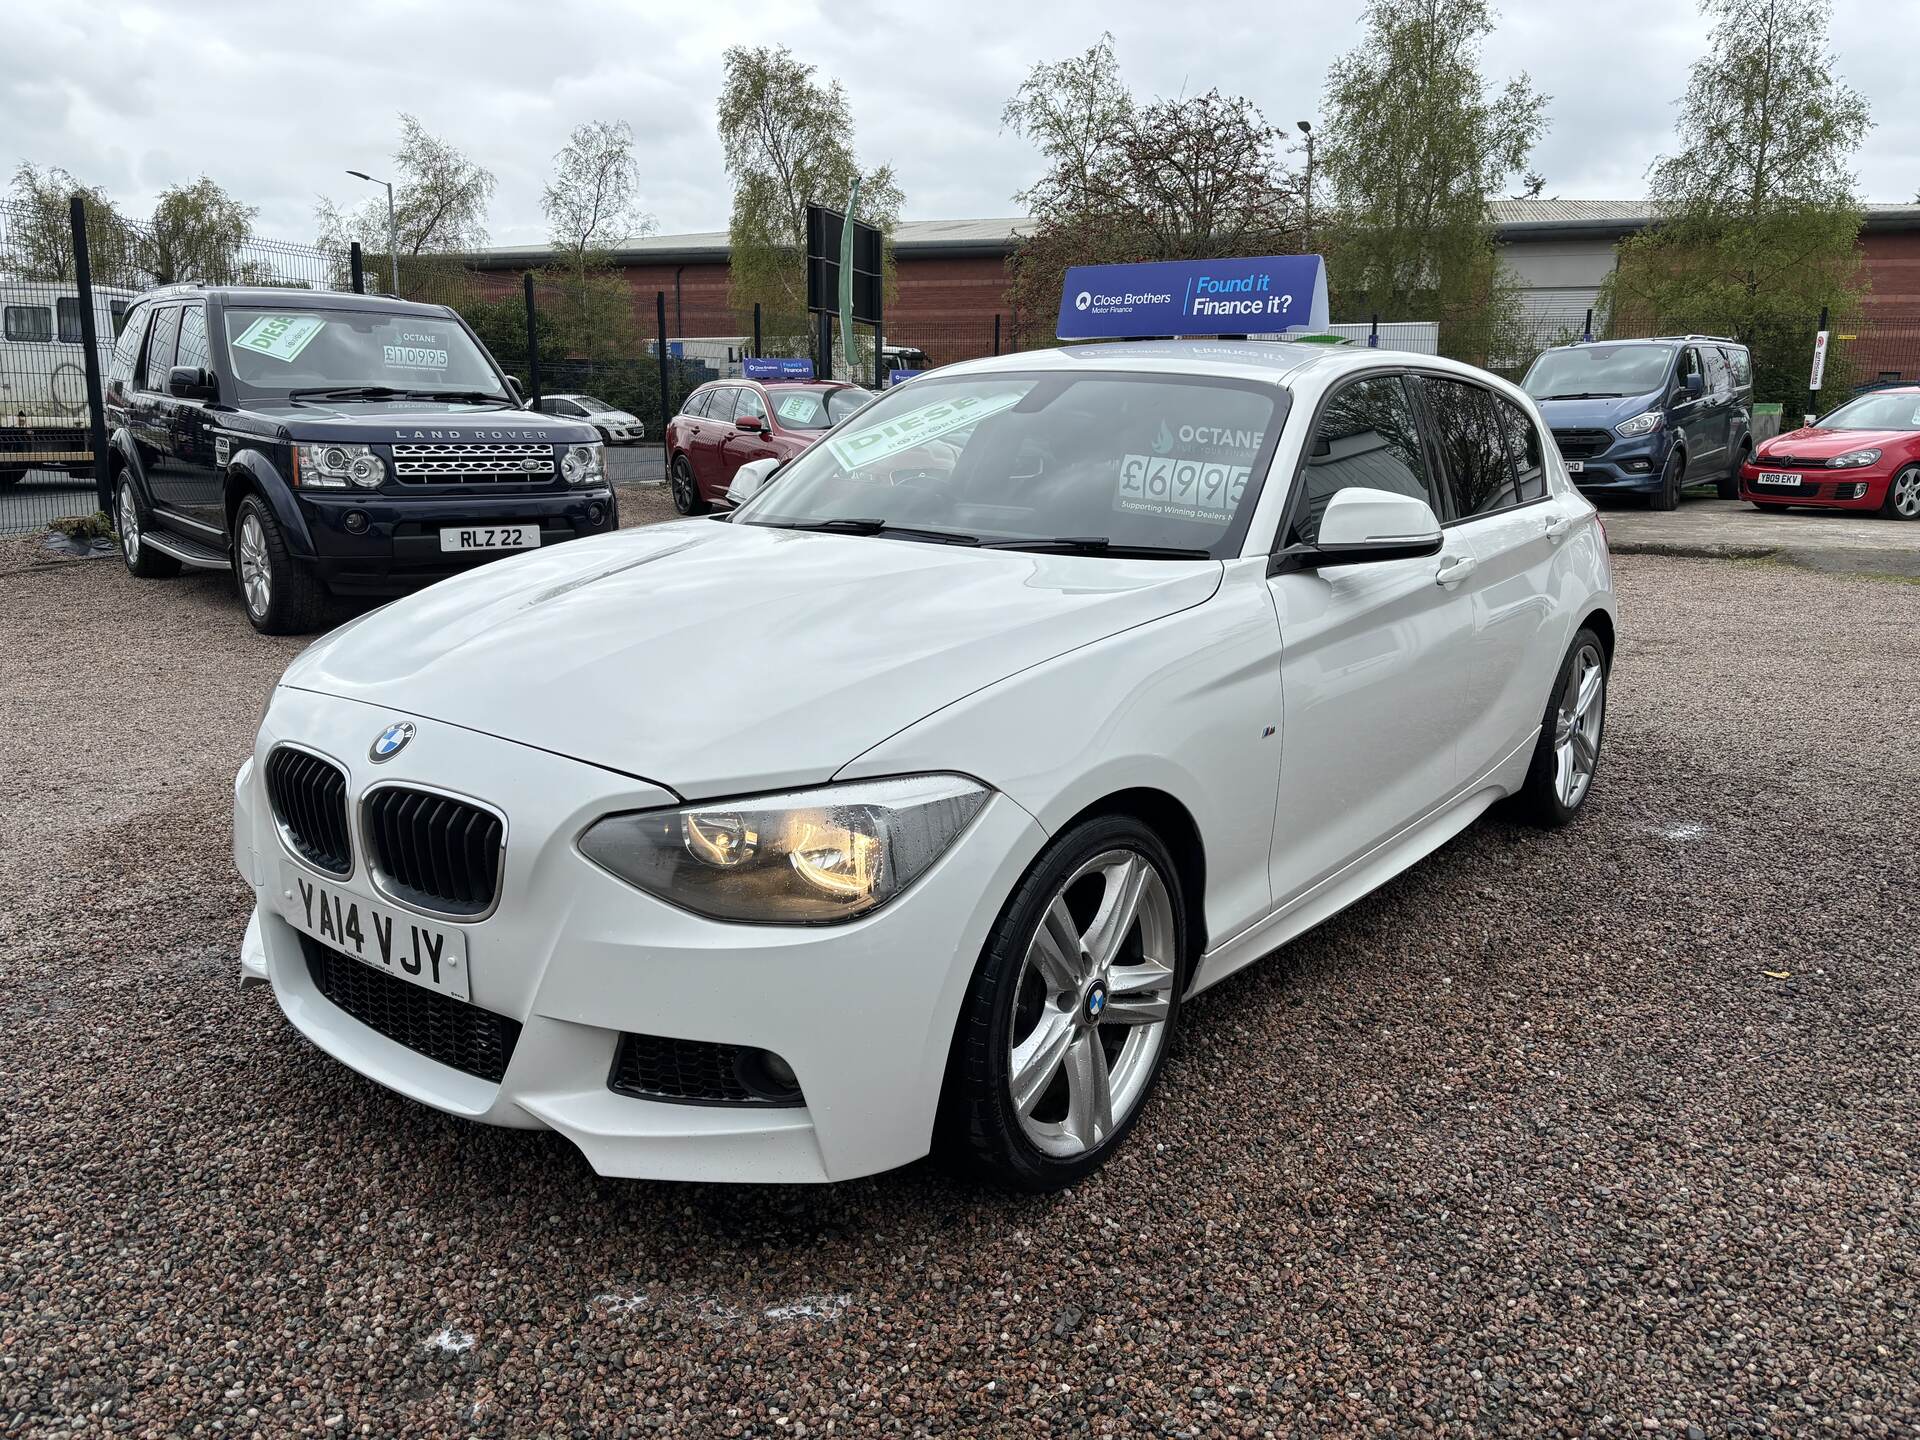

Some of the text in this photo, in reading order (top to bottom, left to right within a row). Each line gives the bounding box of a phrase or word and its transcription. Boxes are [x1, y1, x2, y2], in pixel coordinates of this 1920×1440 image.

[1197, 274, 1271, 293] Found it
[1093, 292, 1171, 306] Close Brothers
[1193, 295, 1293, 316] Finance it?
[1110, 306, 1133, 314] Finance
[403, 333, 437, 343] OCTANE
[385, 347, 447, 365] £10995
[395, 430, 549, 439] LAND ROVER
[1178, 424, 1265, 449] OCTANE
[1122, 459, 1251, 503] £6995
[1760, 473, 1798, 484] YB09 EKV
[1121, 501, 1162, 514] Supporting
[1164, 505, 1196, 518] Winning
[1197, 510, 1226, 521] Dealers
[460, 529, 523, 548] RLZ 22
[298, 877, 444, 985] YA14 VJY
